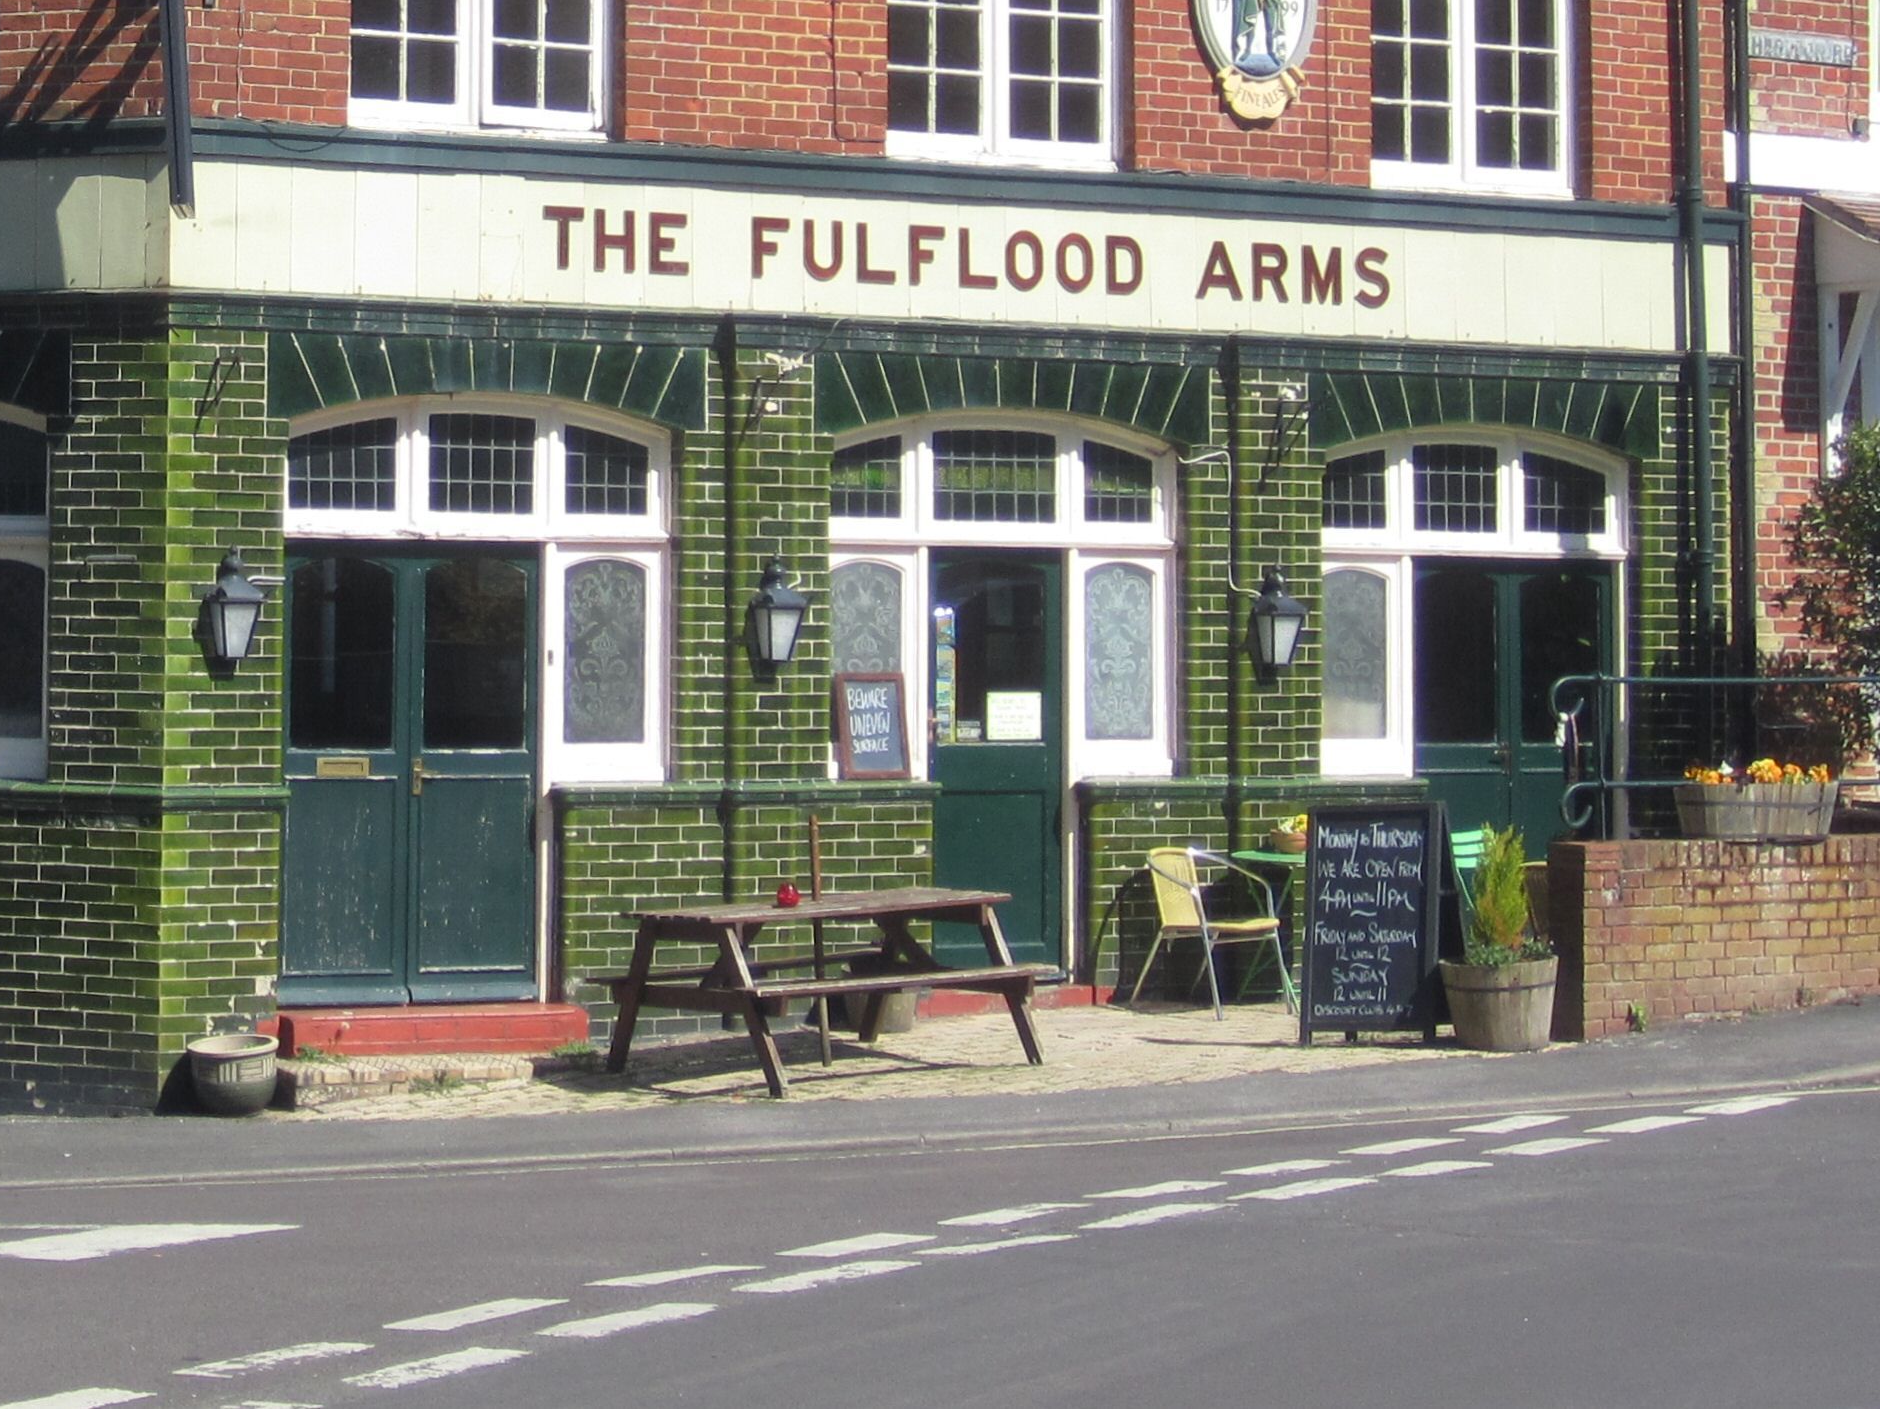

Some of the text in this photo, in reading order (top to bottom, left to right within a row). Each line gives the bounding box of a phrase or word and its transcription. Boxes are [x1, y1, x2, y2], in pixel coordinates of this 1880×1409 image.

[542, 205, 1391, 310] THE FULFLOOD ARMS
[847, 687, 888, 711] BEWARE
[849, 711, 890, 737] UNEVEN
[852, 736, 889, 754] SURFACE
[1318, 825, 1359, 864] MONDAY
[1369, 822, 1425, 858] THURSDAY
[1318, 859, 1336, 878] WE
[1341, 859, 1362, 878] ARE
[1365, 855, 1399, 878] OPEN
[1315, 921, 1346, 945] FRIDAY
[1368, 921, 1417, 948] SATURDAY
[1336, 945, 1349, 961] 12
[1377, 944, 1392, 962] 12
[1331, 967, 1388, 986] SUNDAY
[1333, 985, 1346, 1002] 12
[1377, 986, 1387, 1002] 11
